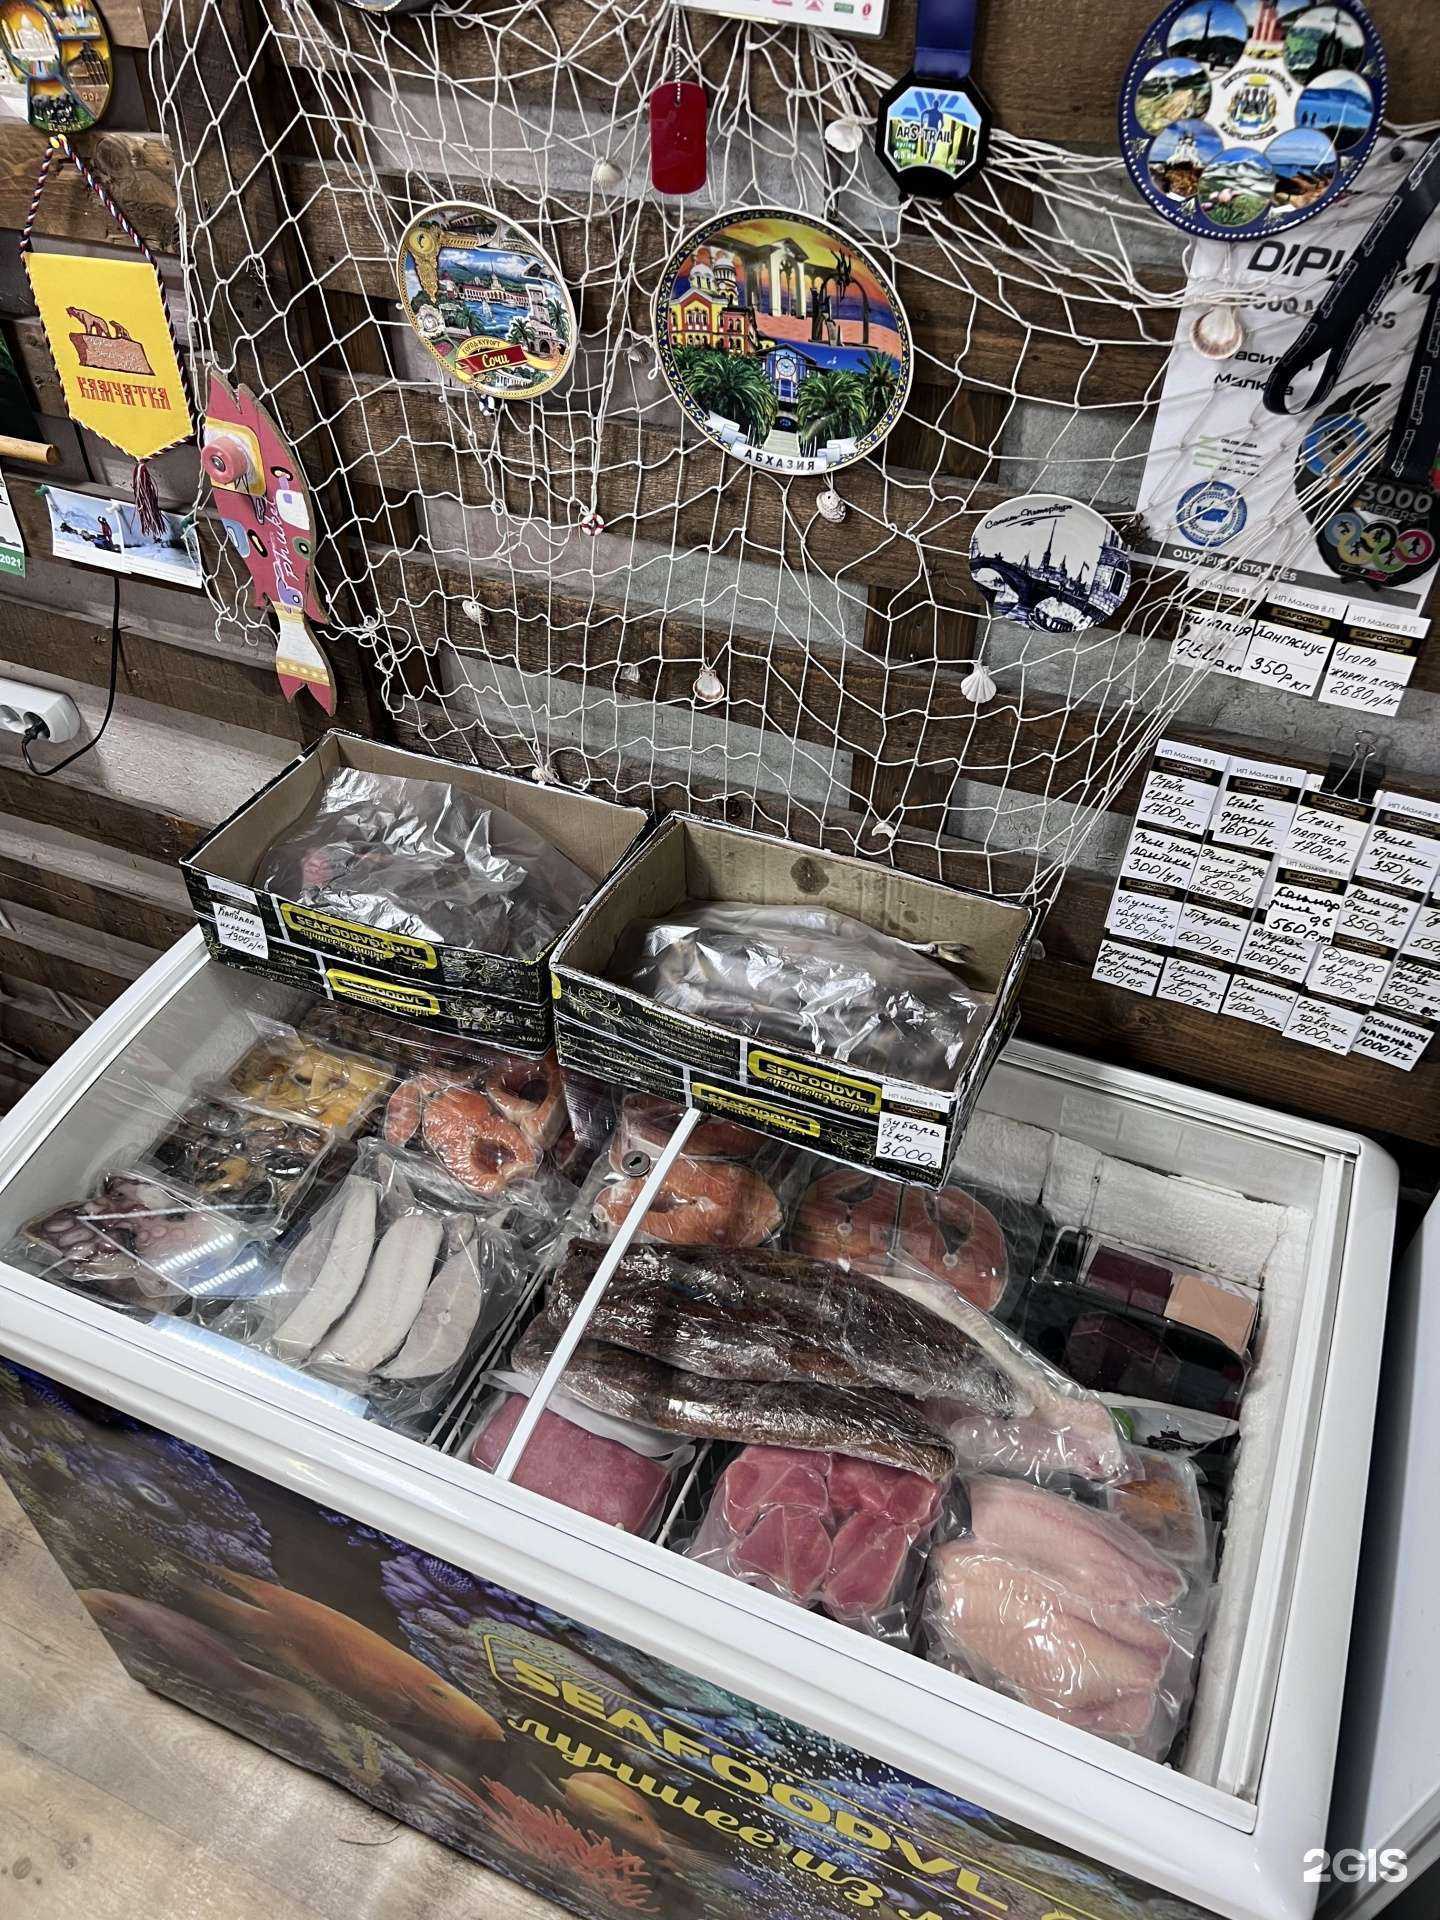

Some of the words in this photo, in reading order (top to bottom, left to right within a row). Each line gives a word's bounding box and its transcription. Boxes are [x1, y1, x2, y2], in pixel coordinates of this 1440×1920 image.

[896, 126, 918, 140] ARS
[923, 128, 953, 143] TRAIL
[482, 353, 510, 368] Сочи
[1214, 373, 1294, 396] Малкв
[744, 449, 815, 471] АБХАЗИЯ
[1358, 481, 1433, 513] 3000
[1360, 502, 1420, 523] METERS
[1353, 615, 1366, 623] ИП
[1367, 618, 1400, 631] Малков
[1336, 646, 1378, 667] Угорь
[1296, 810, 1345, 832] Стейк
[766, 1063, 867, 1102] SEAFOODVL
[512, 1658, 1008, 1911] SEAFOODVL
[507, 1718, 775, 1849] лучшее
[792, 1849, 884, 1907] из
